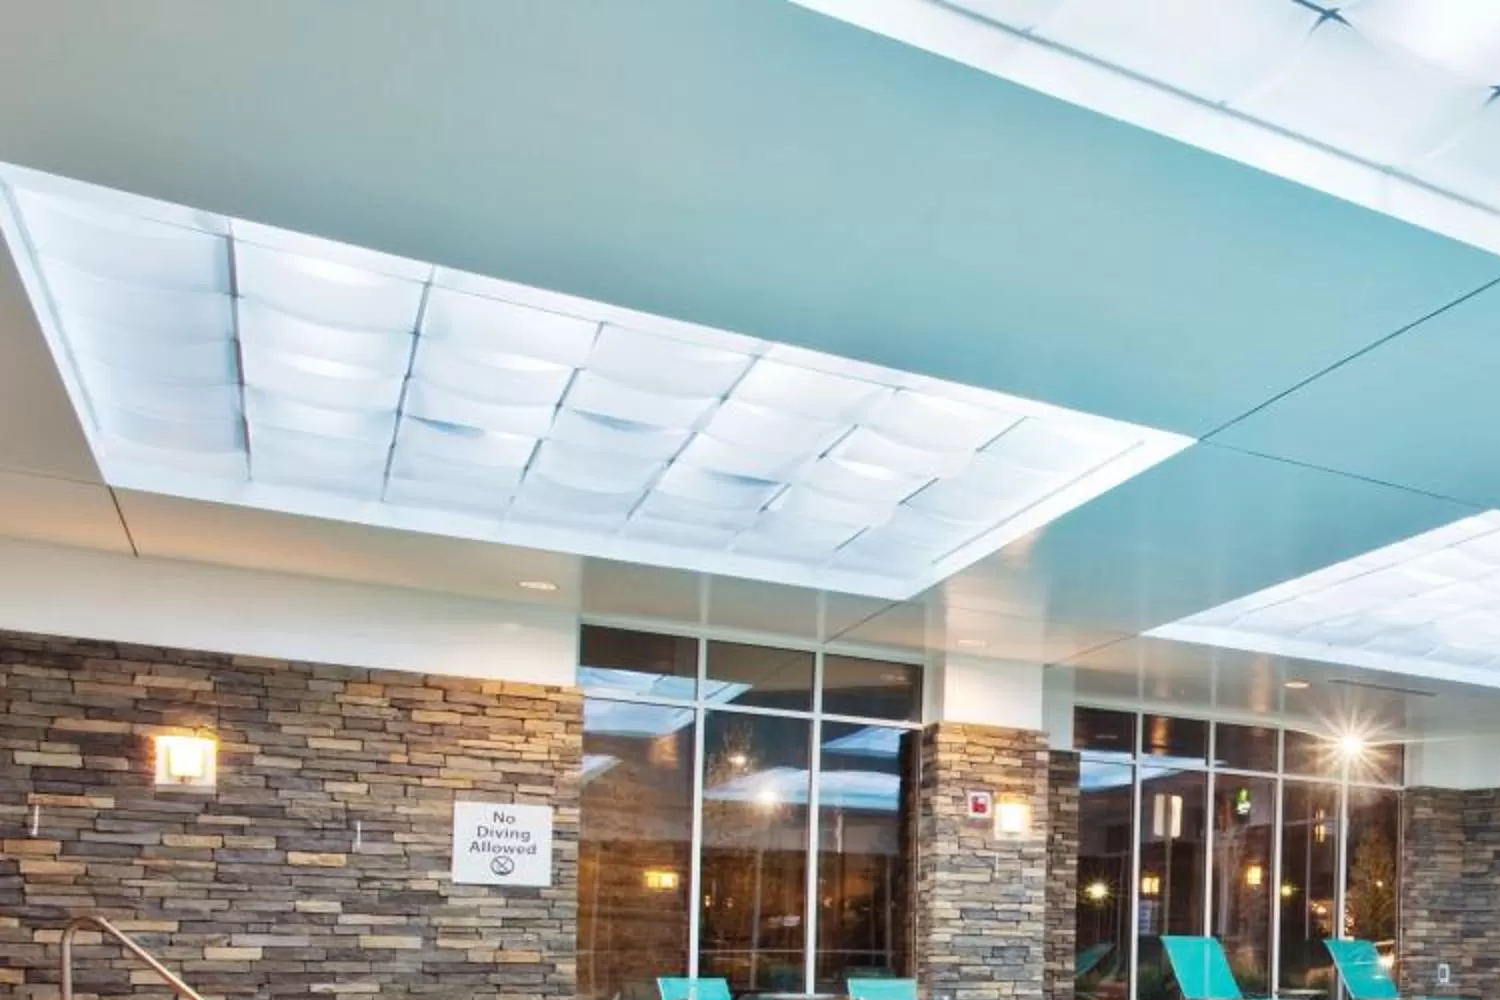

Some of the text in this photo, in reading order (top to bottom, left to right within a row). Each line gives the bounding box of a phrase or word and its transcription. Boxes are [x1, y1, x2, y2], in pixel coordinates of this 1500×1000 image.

[493, 811, 516, 825] No
[477, 825, 531, 842] Diving
[469, 841, 537, 855] Allowed
